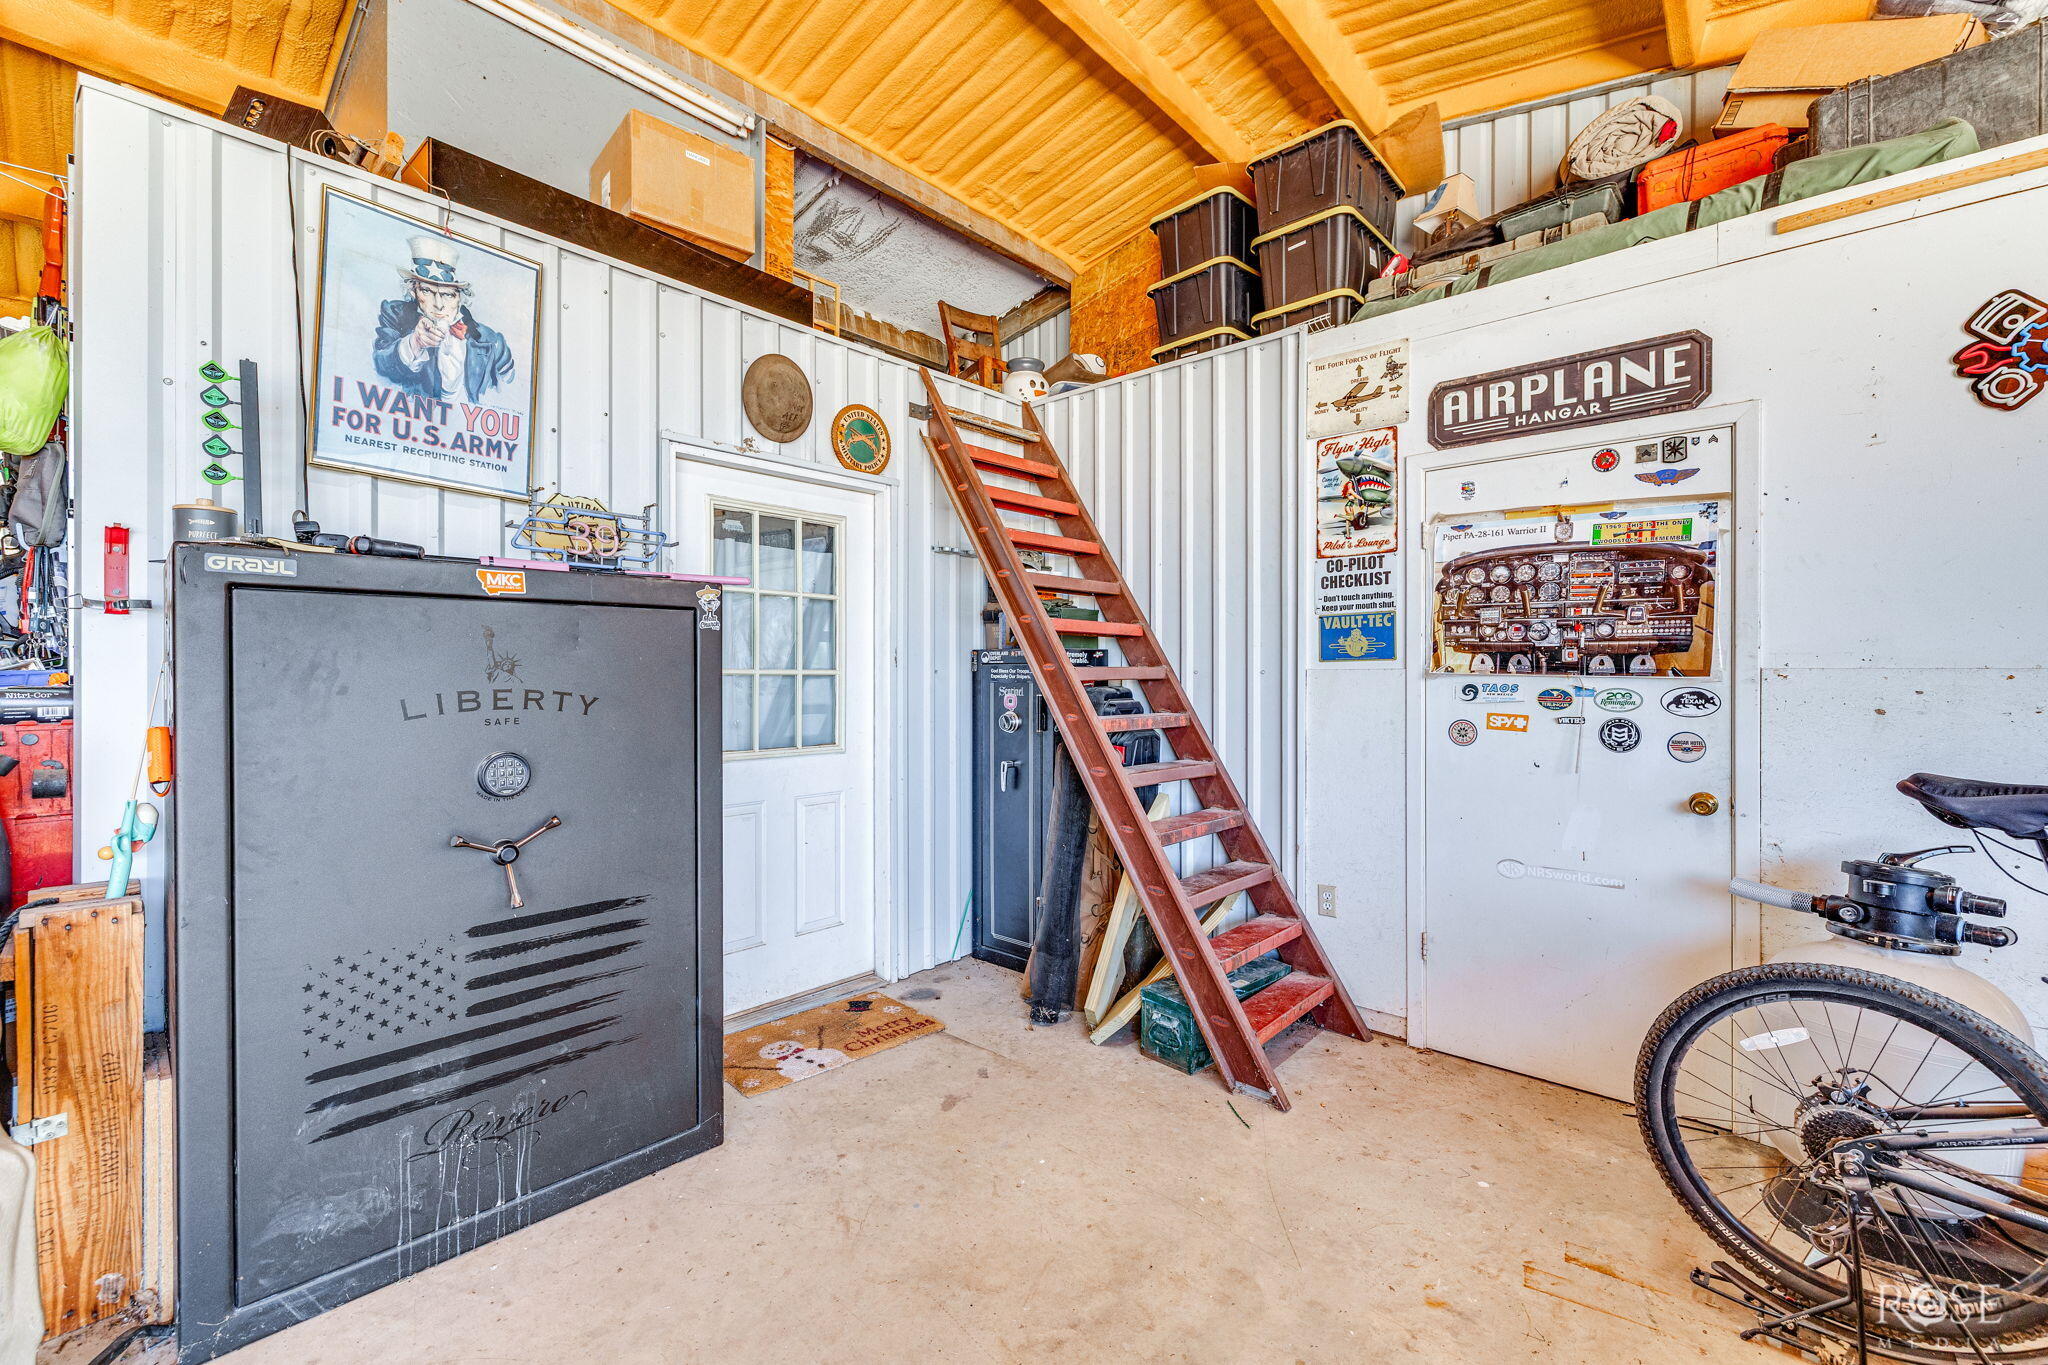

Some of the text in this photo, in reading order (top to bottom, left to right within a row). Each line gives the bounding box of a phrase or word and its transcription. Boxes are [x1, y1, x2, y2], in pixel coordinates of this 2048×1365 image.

[1328, 360, 1344, 369] FOUR
[1345, 355, 1368, 365] FORCES
[1379, 347, 1402, 357] FLIGHT
[1350, 376, 1369, 384] DREAMS
[1443, 343, 1691, 426] AIRPLANE
[333, 375, 520, 441] I WANT YOU
[1349, 406, 1368, 414] REALITY
[1515, 402, 1602, 427] HANGAR
[843, 411, 884, 436] UNITED STATES
[332, 406, 382, 435] FOR
[450, 432, 519, 462] ARMY
[344, 434, 508, 473] NEAREST RECRUITING STATION
[1321, 433, 1391, 459] Flyin' High
[841, 444, 882, 471] MILITARY POLICE
[188, 530, 218, 540] PURRFECT
[1443, 533, 1462, 542] Piper
[1464, 528, 1504, 540] PA-28-161
[1507, 526, 1538, 536] Warrior
[1322, 537, 1391, 551] Pilot's Lounge
[1326, 555, 1385, 573] CO-PILOT
[486, 573, 522, 587] MKC
[1321, 571, 1391, 590] CHECKLIST
[1321, 600, 1396, 612] Keep your mouth shut.
[1323, 591, 1394, 603] Don't touch anything.
[1323, 614, 1392, 629] VAULT-TEC
[1481, 683, 1519, 692] TAOS
[400, 688, 600, 721] LIBERTY
[1600, 699, 1638, 707] Remington
[484, 717, 520, 726] SAFE
[476, 791, 491, 801] MADE
[1527, 866, 1624, 886] NRSworld.com
[844, 1018, 936, 1052] Christmas
[858, 1016, 912, 1039] Merry
[1936, 1138, 2010, 1147] PARATROOPER
[1700, 1205, 1782, 1275] KENDATIRE.COM
